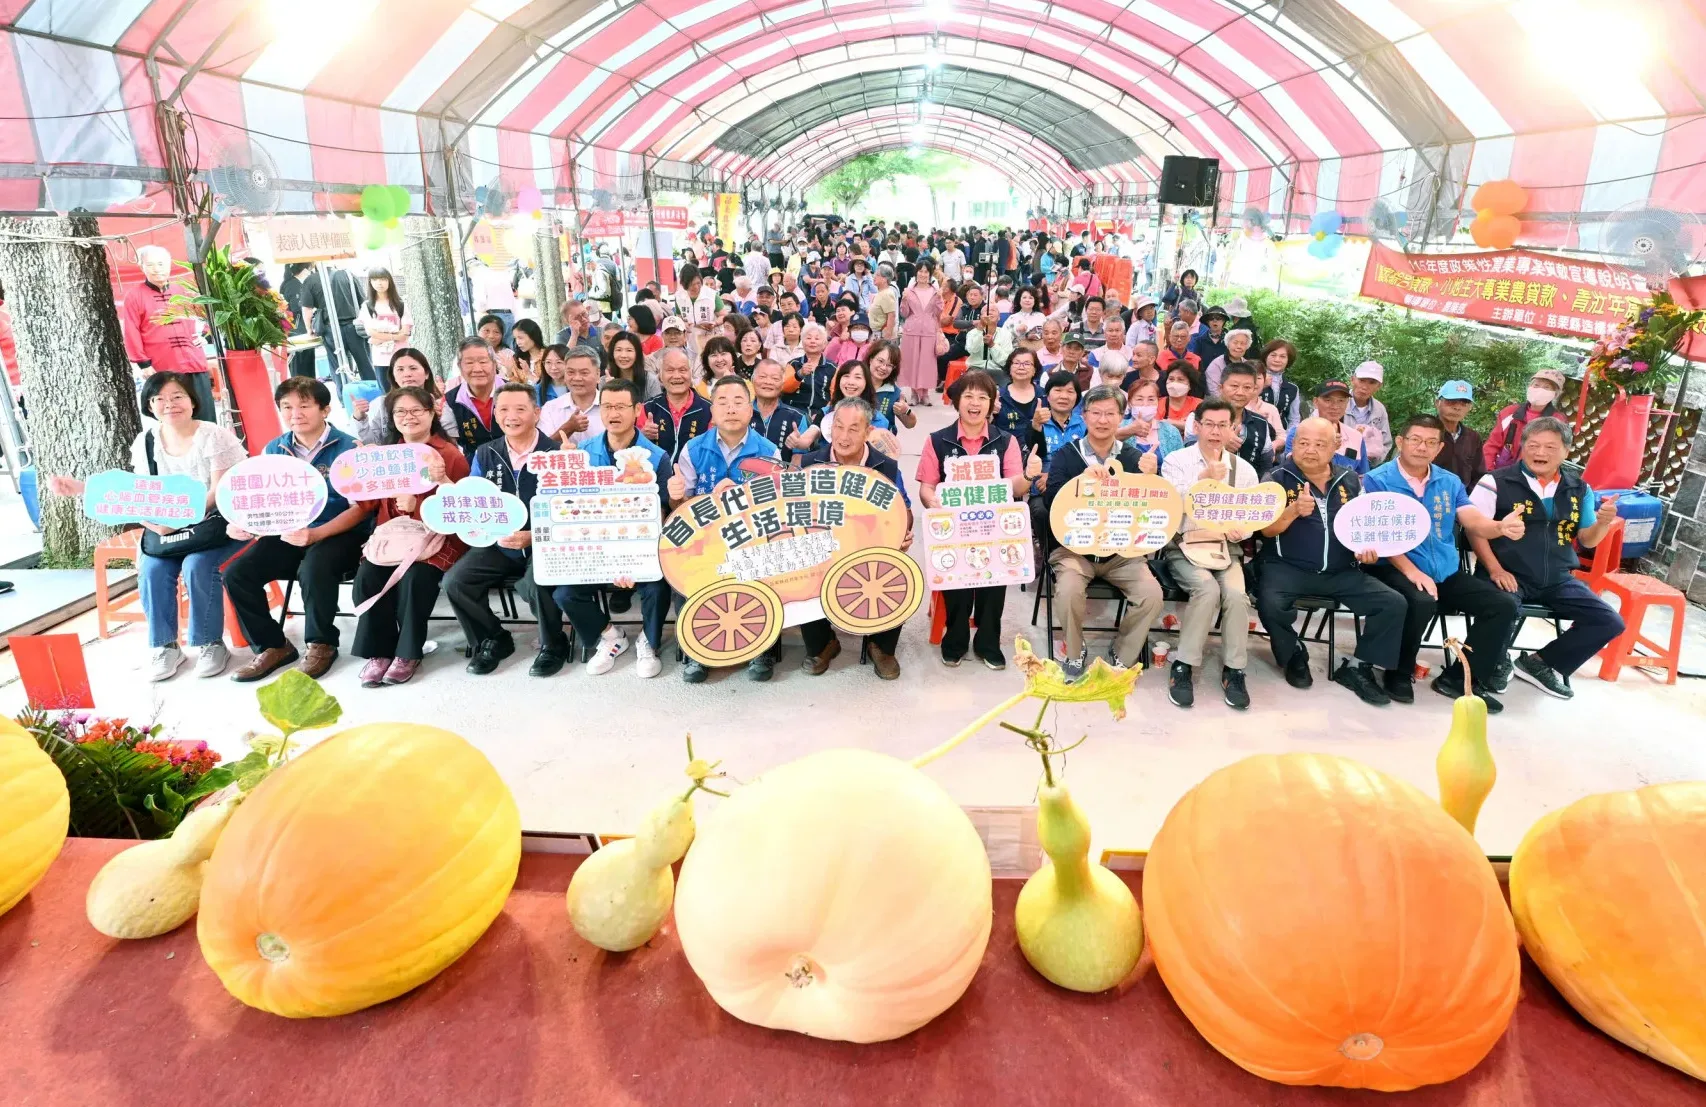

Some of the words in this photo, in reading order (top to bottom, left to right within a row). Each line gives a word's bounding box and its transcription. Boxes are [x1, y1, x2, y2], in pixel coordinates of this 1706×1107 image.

[276, 232, 352, 252] 表演人員準備區
[355, 448, 415, 464] 均衡飲食
[530, 453, 585, 470] 未精製
[951, 460, 995, 481] 減鹽
[230, 471, 315, 491] 腰圍八九十
[366, 477, 411, 492] 多纖維
[541, 470, 615, 487] 全穀雜糧
[231, 490, 316, 511] 健康常維持
[442, 495, 504, 508] 規律運動
[941, 484, 1008, 507] 增健康
[1194, 492, 1277, 506] 定期健康檢查
[96, 503, 195, 518] 健康生活動起來
[662, 469, 898, 547] 首長代言營造健康
[1370, 500, 1396, 512] 防治
[442, 511, 509, 524] 戒菸、少酒
[1193, 508, 1275, 521] 早發現早治療
[1350, 514, 1417, 527] 代謝症候群
[721, 501, 844, 549] 生活環境
[160, 531, 190, 545] PUMA
[1350, 530, 1417, 543] 遠離慢性病
